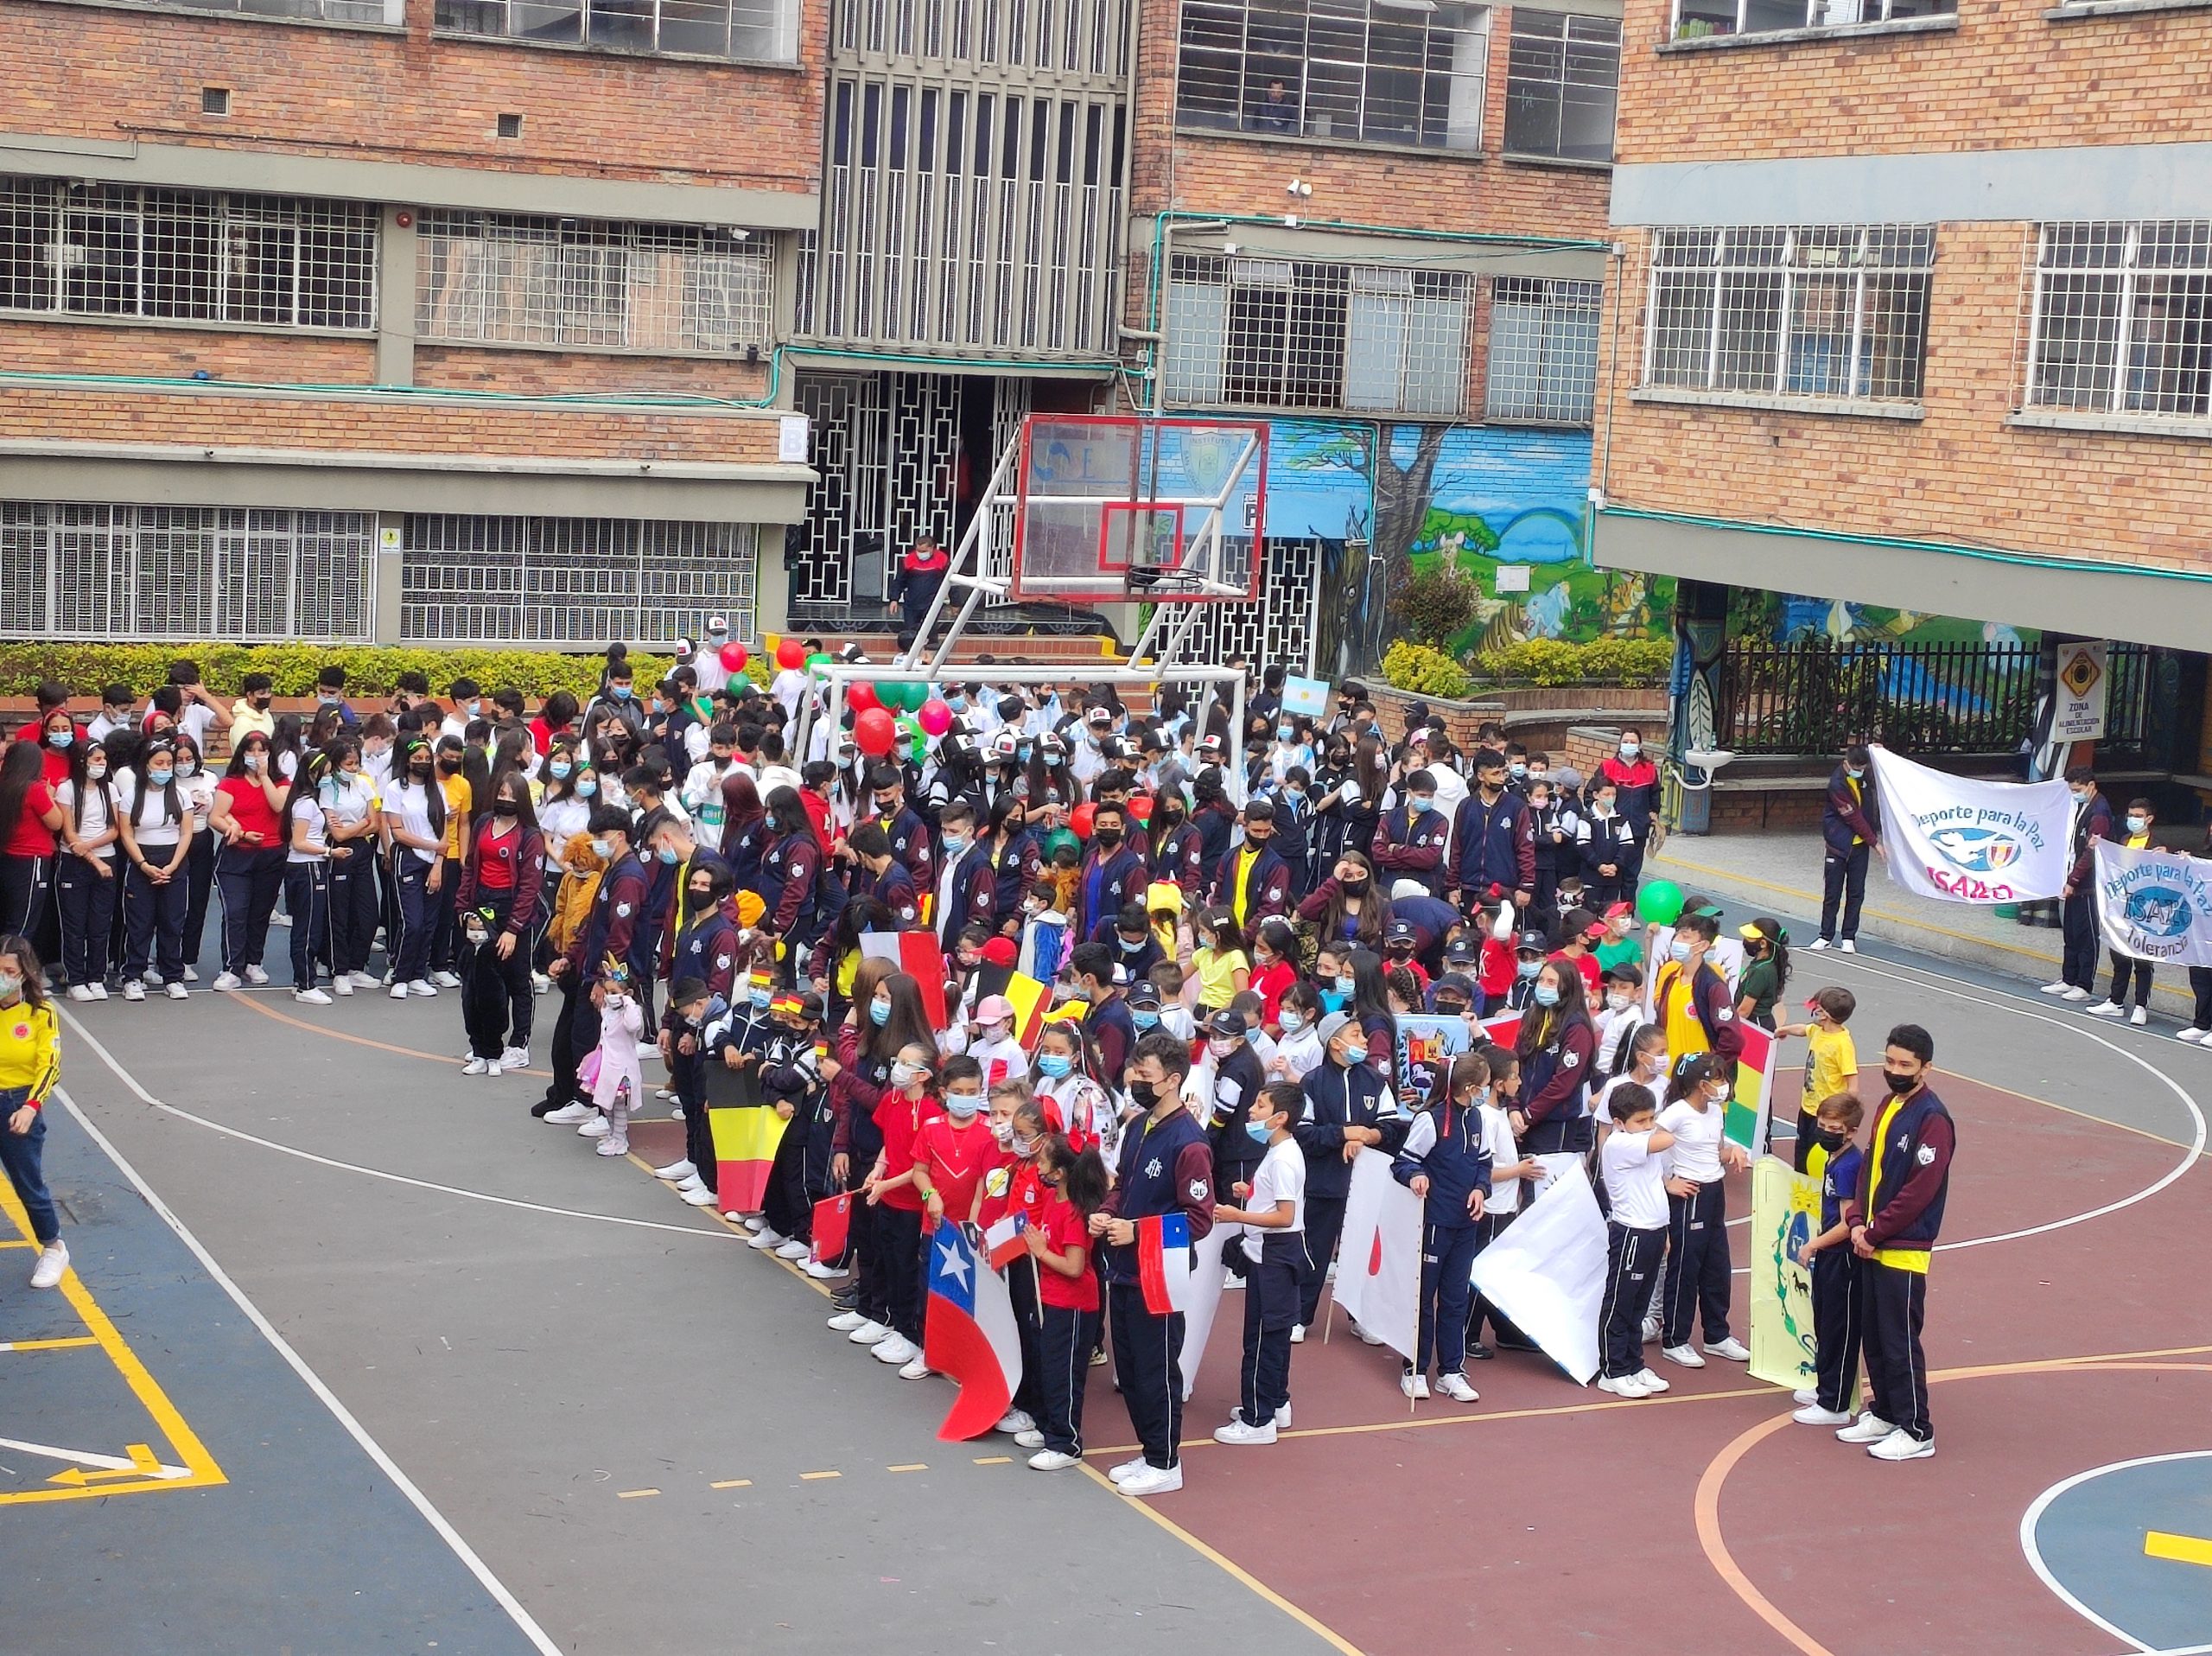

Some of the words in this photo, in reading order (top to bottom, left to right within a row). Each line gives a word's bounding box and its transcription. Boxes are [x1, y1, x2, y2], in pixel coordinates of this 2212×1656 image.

[784, 429, 803, 453] B
[1189, 436, 1231, 445] INSTITUTO
[2069, 702, 2089, 712] ZONA
[1976, 808, 2012, 825] para
[2013, 812, 2026, 831] la
[2025, 821, 2044, 852] Paz
[2156, 863, 2181, 882] para
[2184, 865, 2193, 889] la
[2127, 926, 2188, 958] Tolerancia
